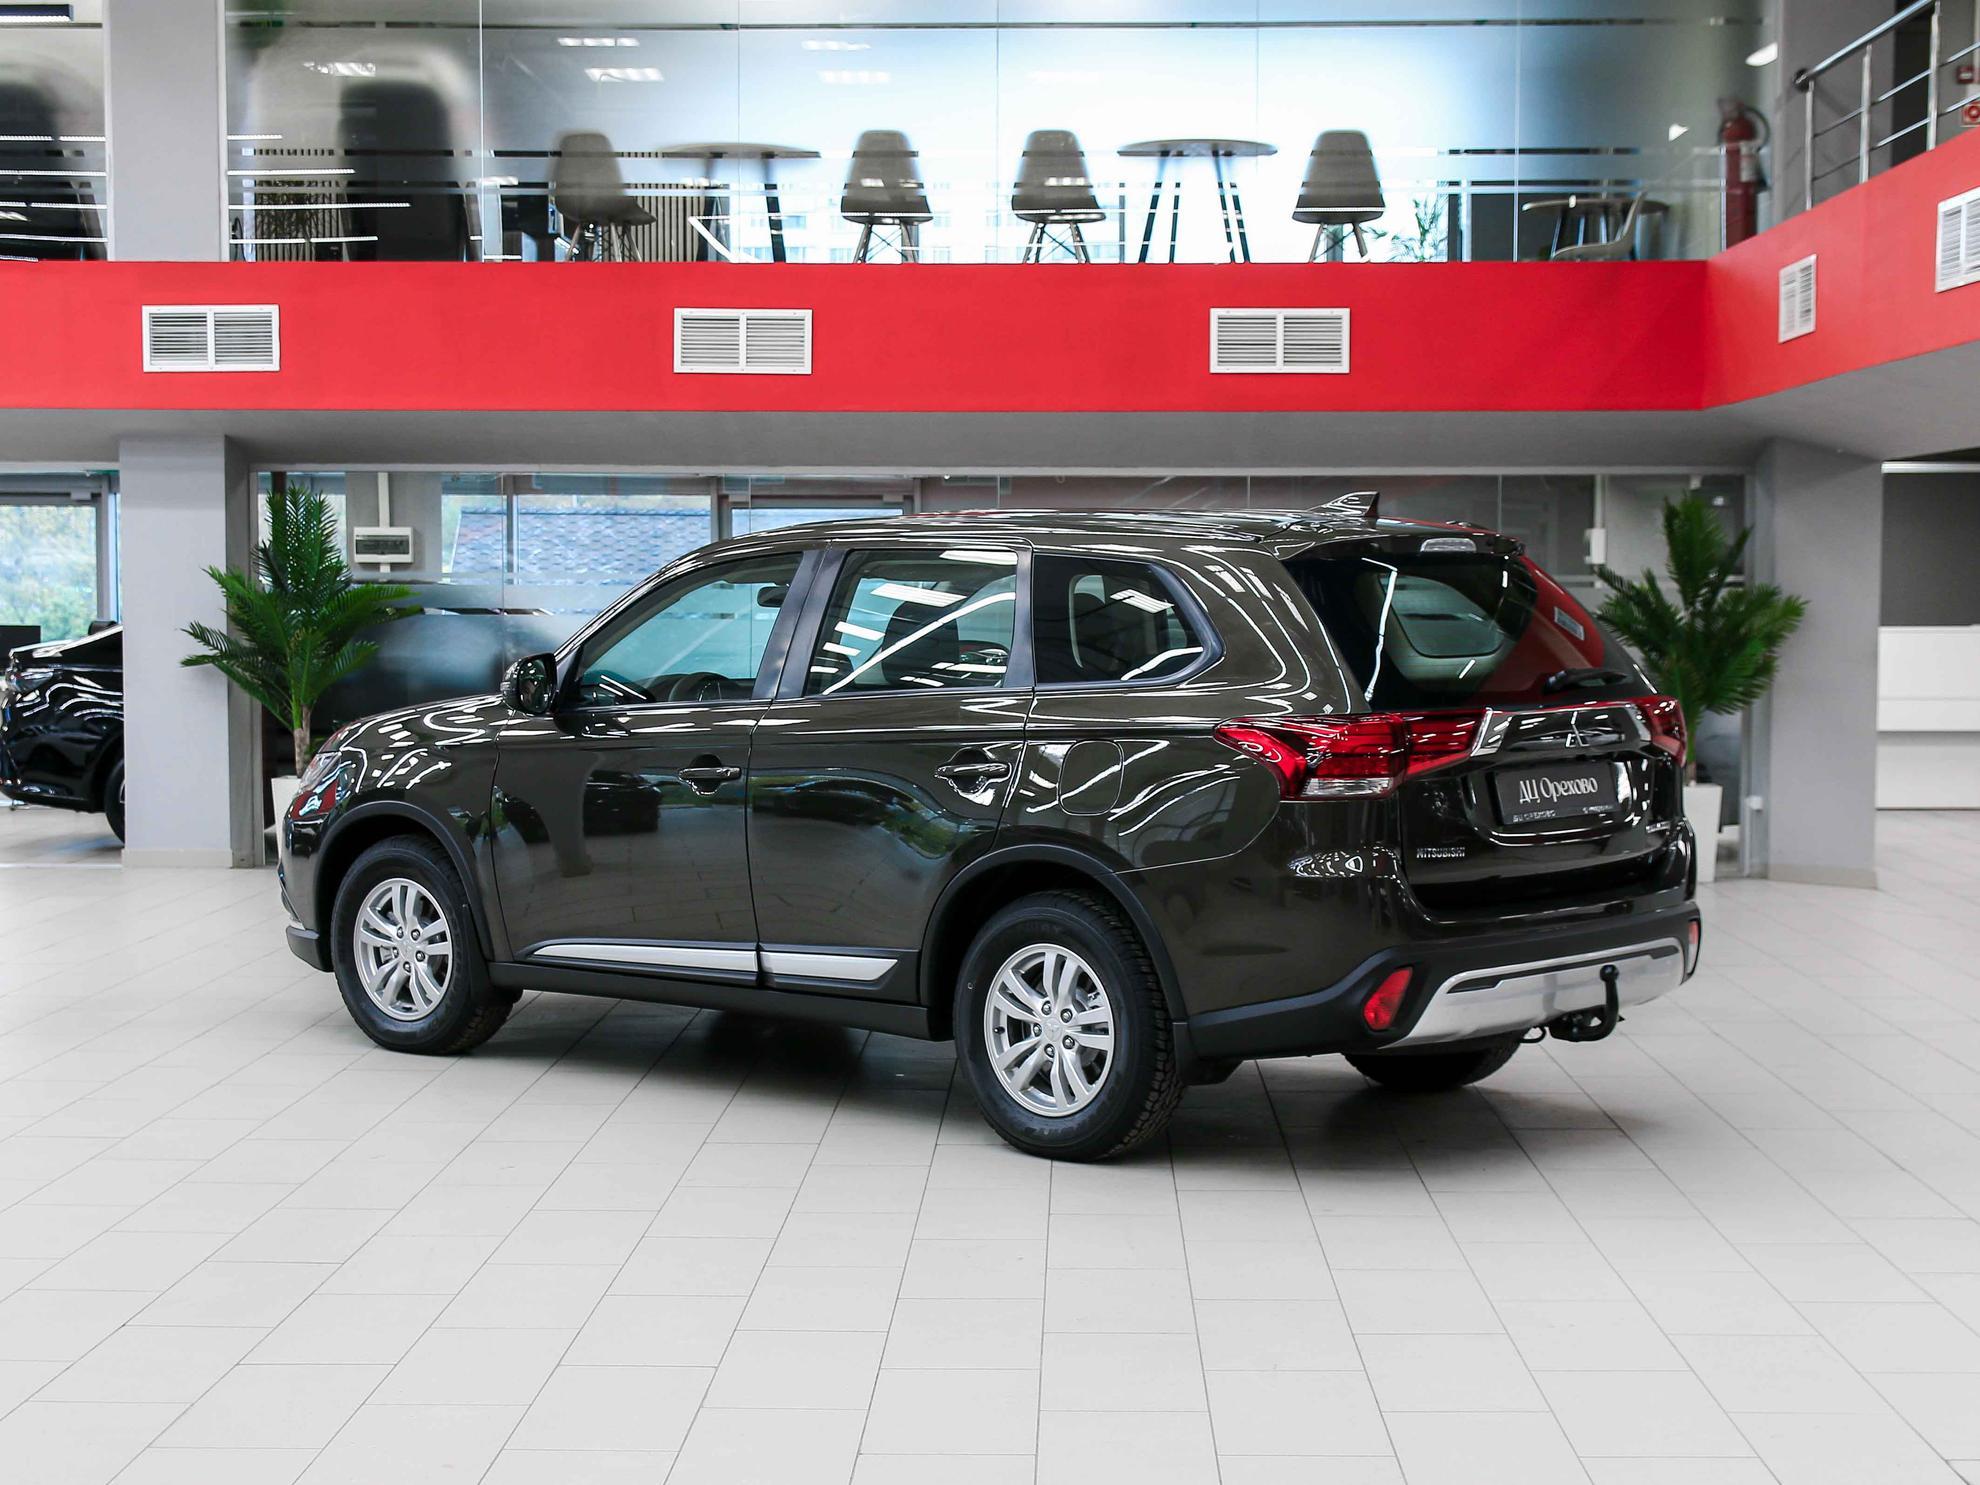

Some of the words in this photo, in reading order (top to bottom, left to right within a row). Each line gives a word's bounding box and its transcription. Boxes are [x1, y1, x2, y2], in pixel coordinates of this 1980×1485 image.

[1520, 779, 1540, 804] ДЦ
[1540, 777, 1598, 802] Орехово
[1416, 847, 1465, 858] MITSUBISHI
